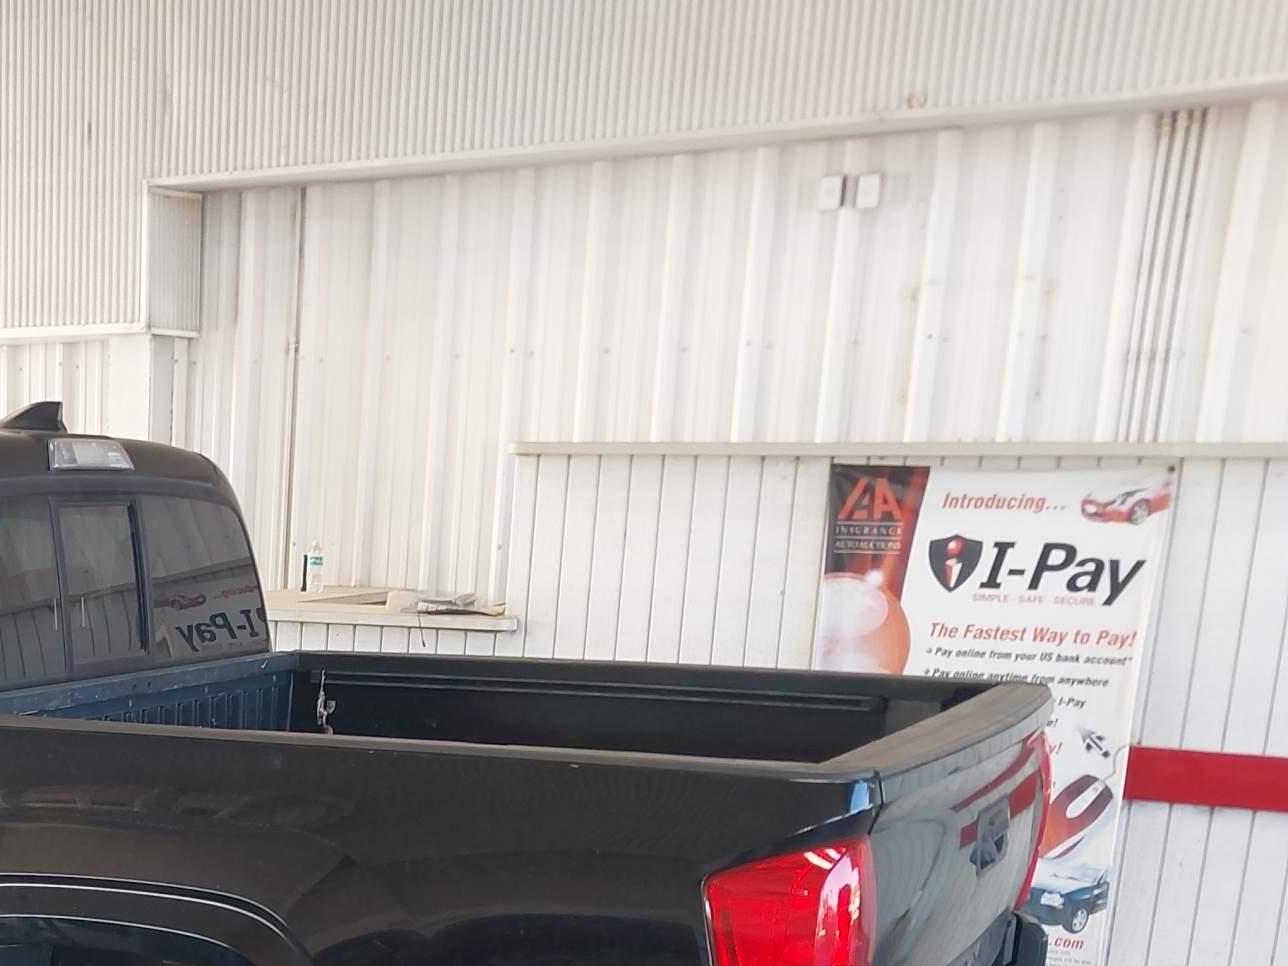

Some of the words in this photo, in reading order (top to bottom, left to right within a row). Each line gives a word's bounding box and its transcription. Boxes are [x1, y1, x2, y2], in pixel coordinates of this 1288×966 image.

[942, 493, 1065, 513] Introducing...
[979, 541, 1146, 606] I-Pay
[930, 622, 959, 639] The
[963, 624, 1027, 642] Fastest
[1032, 627, 1068, 647] Way
[1073, 628, 1091, 645] to
[1095, 629, 1137, 649] Pay!
[934, 647, 953, 658] Pay
[955, 648, 986, 658] online
[989, 650, 1013, 660] from
[1014, 653, 1037, 662] your
[1039, 651, 1054, 663] US
[1055, 653, 1080, 664] bank
[1057, 676, 1110, 687] anywhere
[1058, 696, 1087, 709] I-Pay
